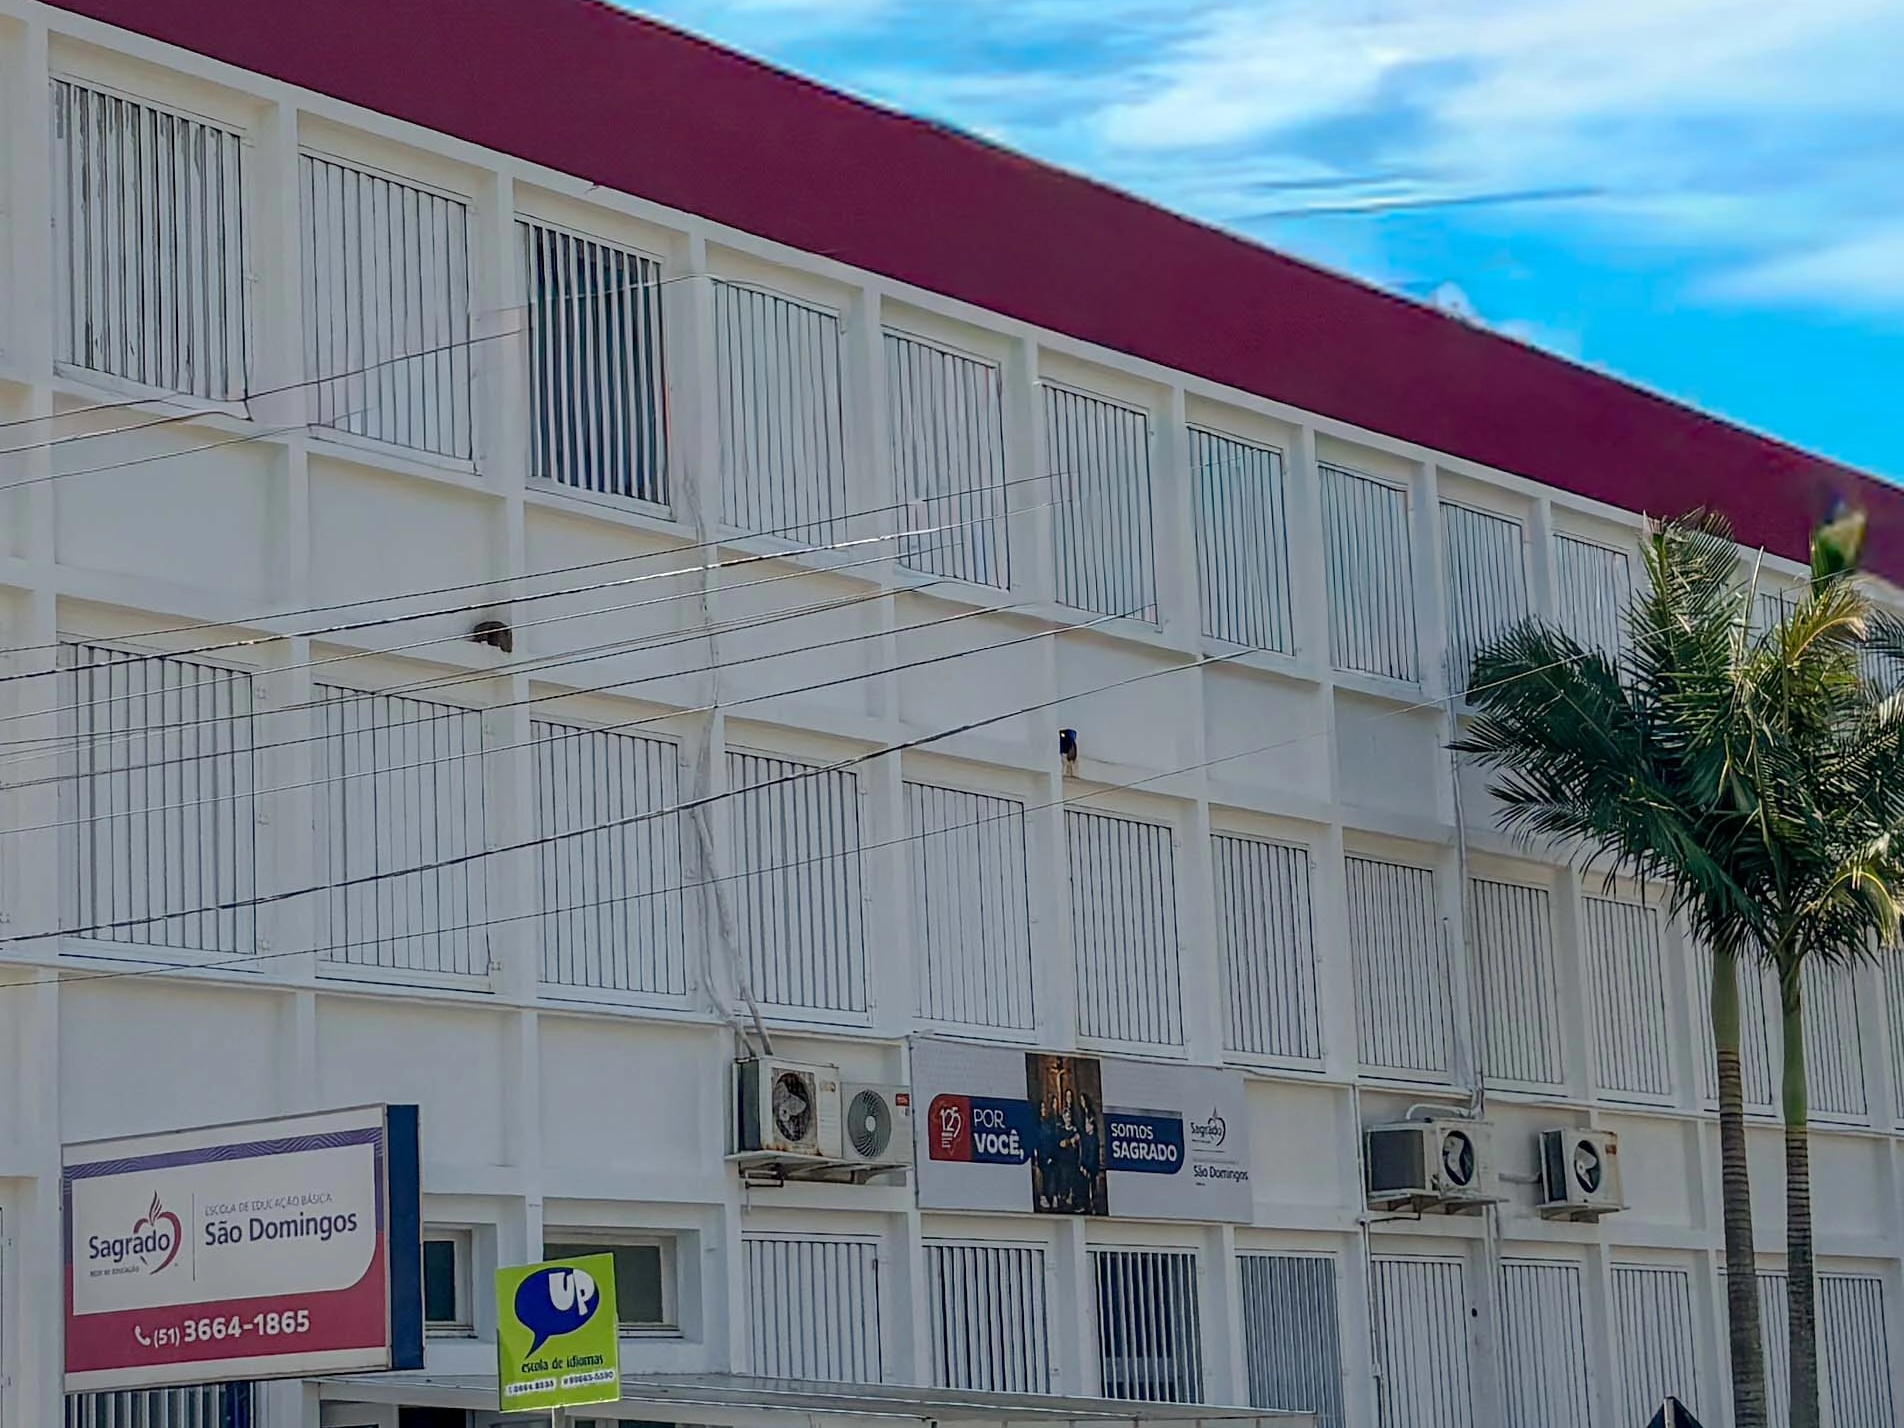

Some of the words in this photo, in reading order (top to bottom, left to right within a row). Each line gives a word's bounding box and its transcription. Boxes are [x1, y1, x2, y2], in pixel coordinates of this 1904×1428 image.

[973, 1108, 1006, 1129] POR
[1110, 1123, 1154, 1140] somos
[1189, 1121, 1223, 1139] Sagrado
[973, 1129, 1025, 1160] VOCÊ,
[1112, 1141, 1178, 1162] SAGRADO
[1193, 1164, 1208, 1178] São
[1209, 1165, 1249, 1183] Domingos
[205, 1203, 236, 1217] ESCOLA
[238, 1202, 249, 1213] DE
[205, 1219, 243, 1246] São
[249, 1211, 358, 1242] Domingos
[89, 1229, 171, 1263] Sagrado
[549, 1269, 596, 1316] UP
[153, 1326, 181, 1348] (51)
[183, 1310, 310, 1343] 3664-1865
[521, 1358, 549, 1373] escola
[552, 1357, 564, 1370] de
[566, 1353, 604, 1369] idiomas
